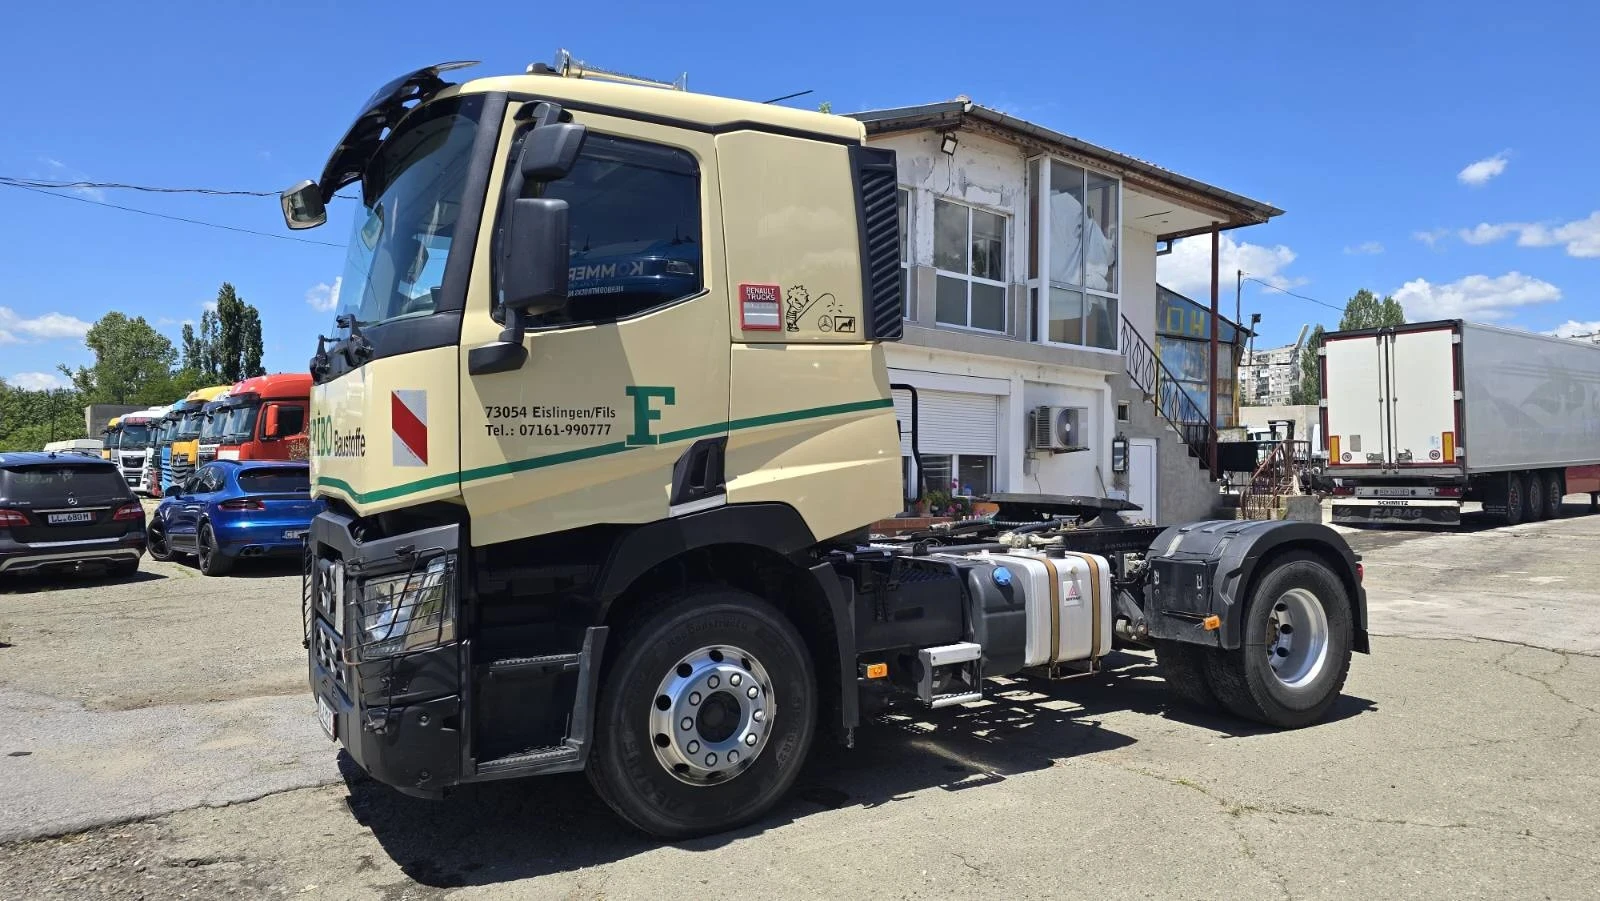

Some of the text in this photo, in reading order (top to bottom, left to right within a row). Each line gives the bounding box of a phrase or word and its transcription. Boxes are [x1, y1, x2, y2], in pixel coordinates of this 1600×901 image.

[747, 293, 776, 301] TRUCKS
[485, 406, 616, 420] 73054 Eislingen/Fils
[625, 386, 675, 445] F
[485, 423, 612, 436] Tel.: 07161-990777
[334, 427, 366, 457] Baustoffe
